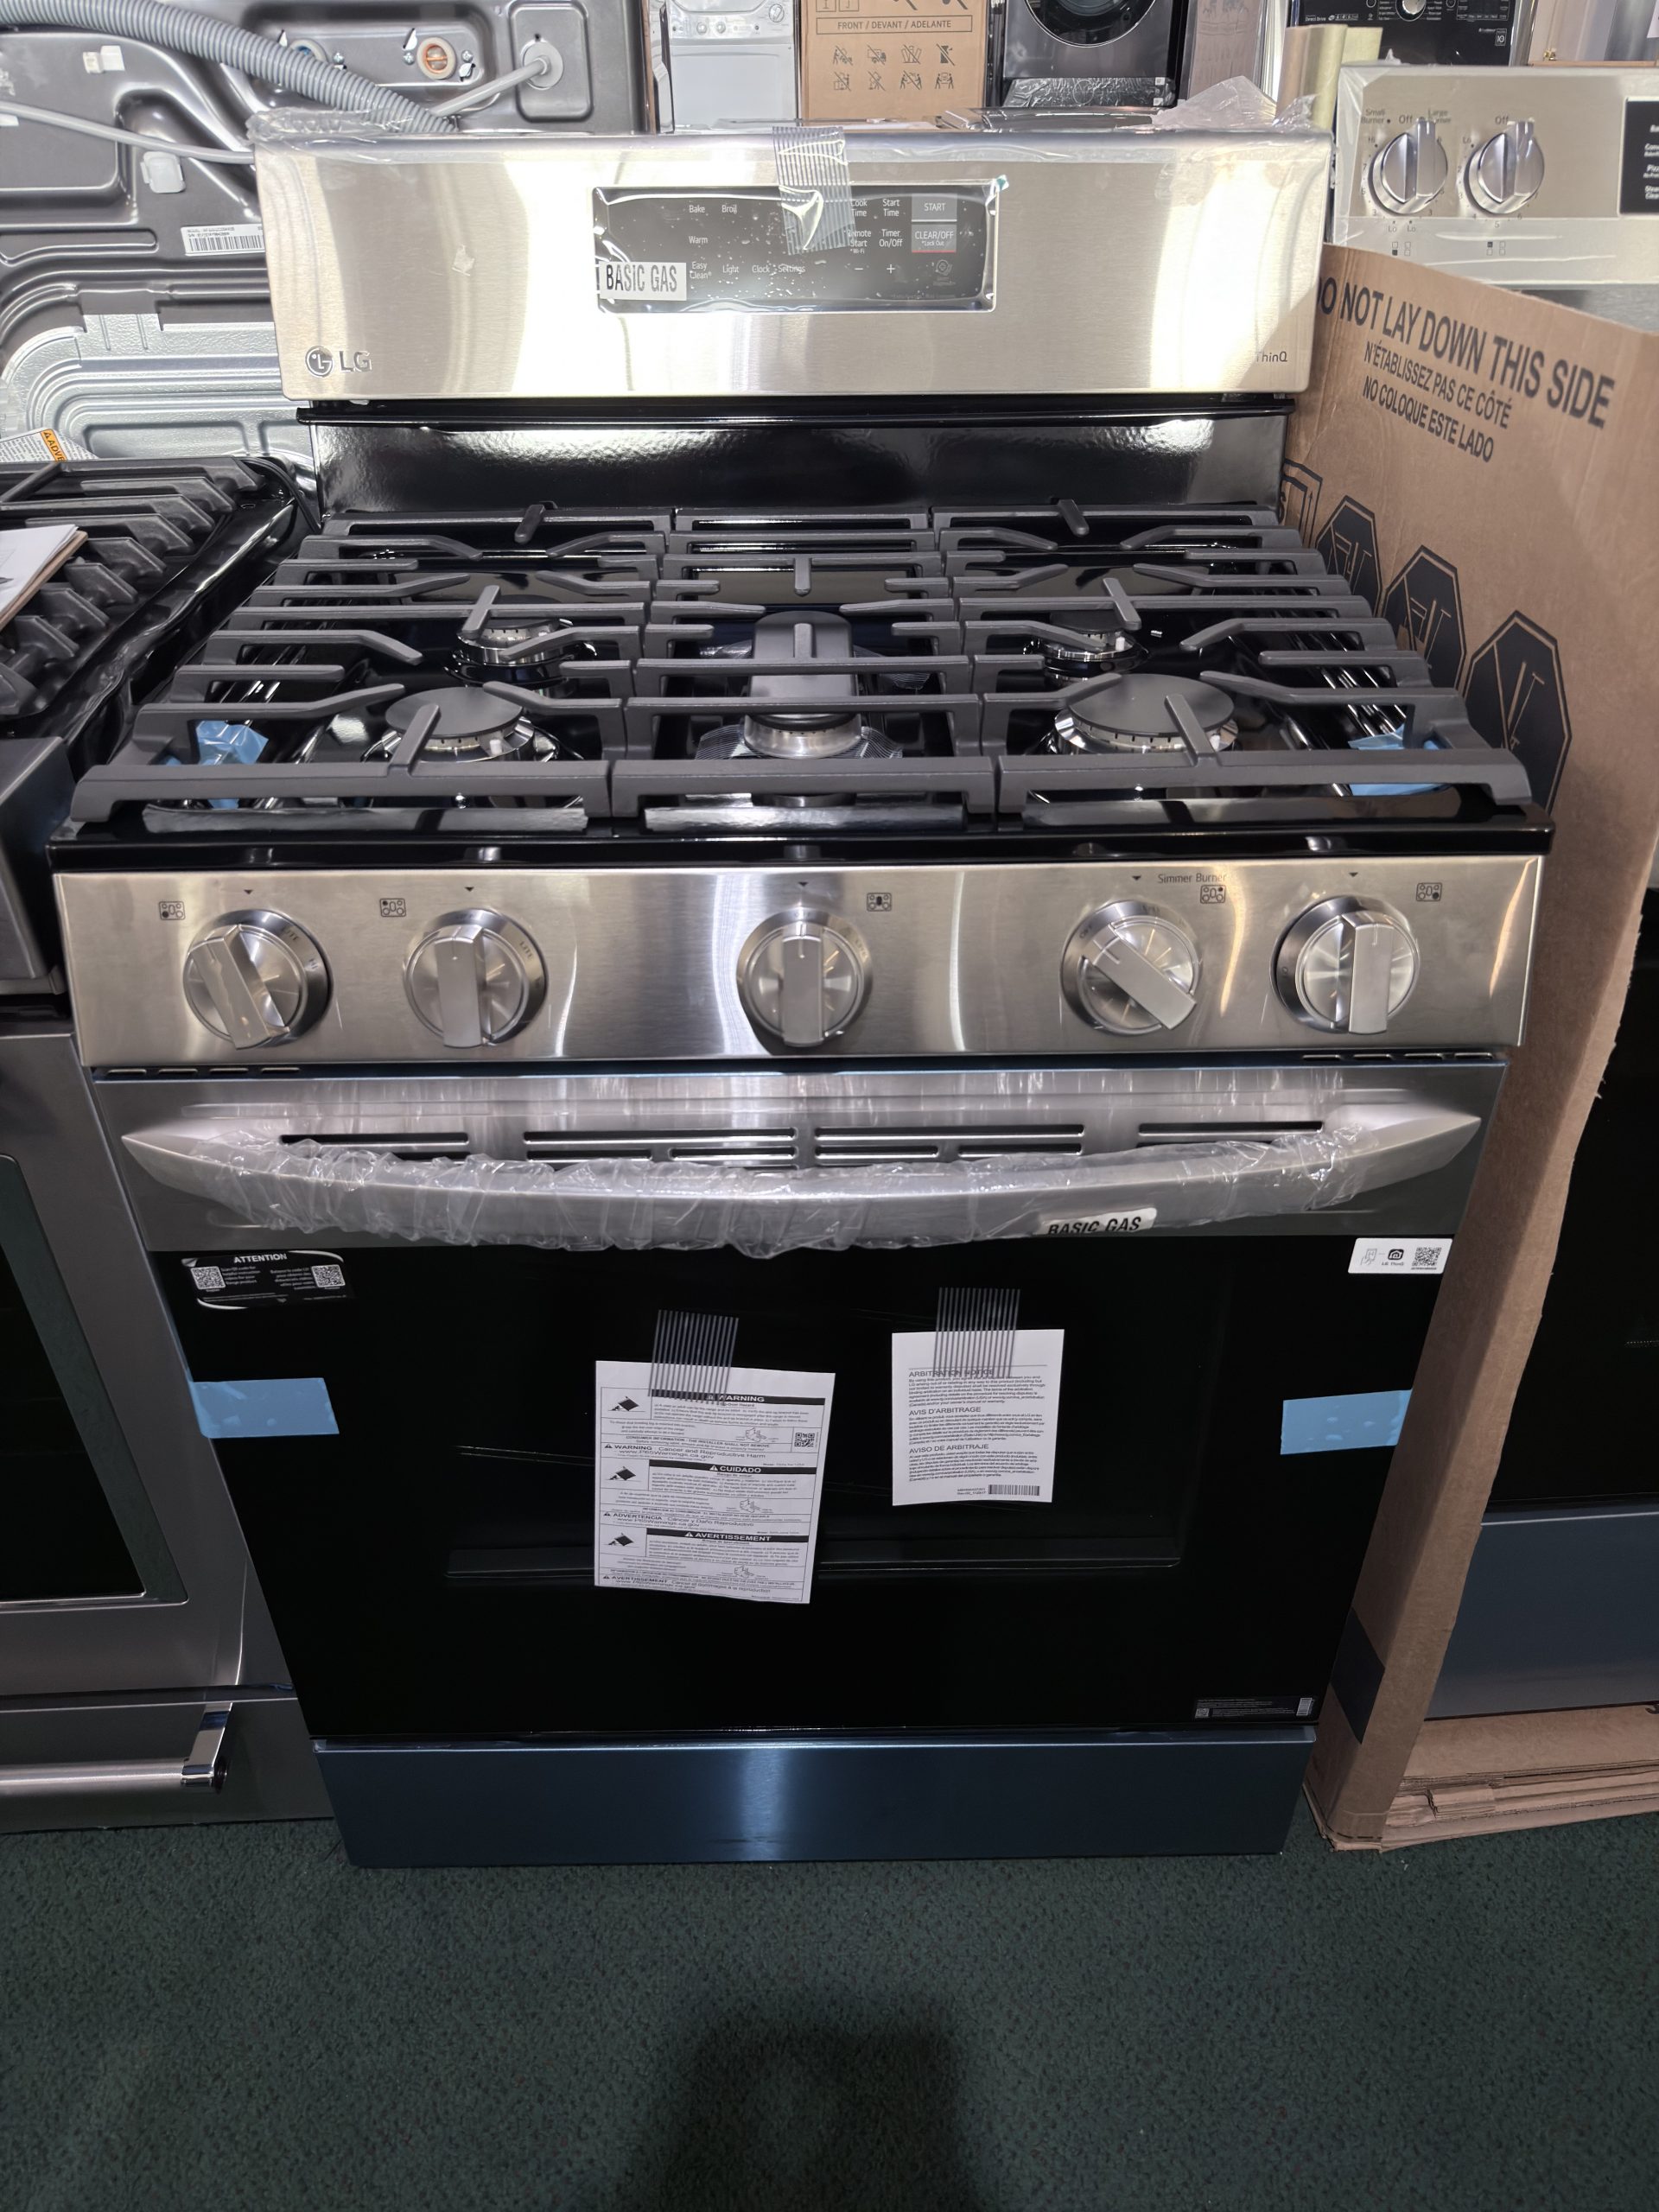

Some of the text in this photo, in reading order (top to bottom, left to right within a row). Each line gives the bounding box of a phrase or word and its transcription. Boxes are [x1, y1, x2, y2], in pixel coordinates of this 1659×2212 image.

[1428, 109, 1448, 118] Large
[1399, 115, 1414, 124] Off
[1495, 116, 1510, 124] Off
[882, 199, 900, 207] Start
[924, 203, 946, 212] START
[721, 205, 737, 213] Broil
[851, 208, 867, 217] Time
[883, 208, 899, 217] Time
[881, 229, 900, 238] Timer
[914, 231, 954, 240] CLEAR/OFF
[849, 239, 868, 248] Start
[879, 239, 902, 248] On/Off
[692, 262, 707, 270] Easy
[722, 265, 740, 275] Light
[778, 264, 805, 275] Settings
[606, 264, 677, 293] BASIC GAS
[1340, 282, 1384, 331] NOT
[1382, 296, 1421, 346] LAY
[1419, 310, 1487, 374] DOWN
[1490, 335, 1544, 398] THIS
[1547, 359, 1615, 429] SIDE
[339, 351, 372, 372] LG
[1364, 340, 1512, 429] N'ÉTABLISSEZ PAS CE CÔTÉ
[1363, 375, 1494, 462] NO COLOQUE ESTE LADO
[1158, 873, 1227, 883] Simmer Burner
[1048, 1217, 1141, 1235] BASIC GAS
[234, 1253, 287, 1263] ATTENTION
[700, 1449, 745, 1458] Reproductive
[696, 1532, 772, 1541] AVERTISSEMENT
